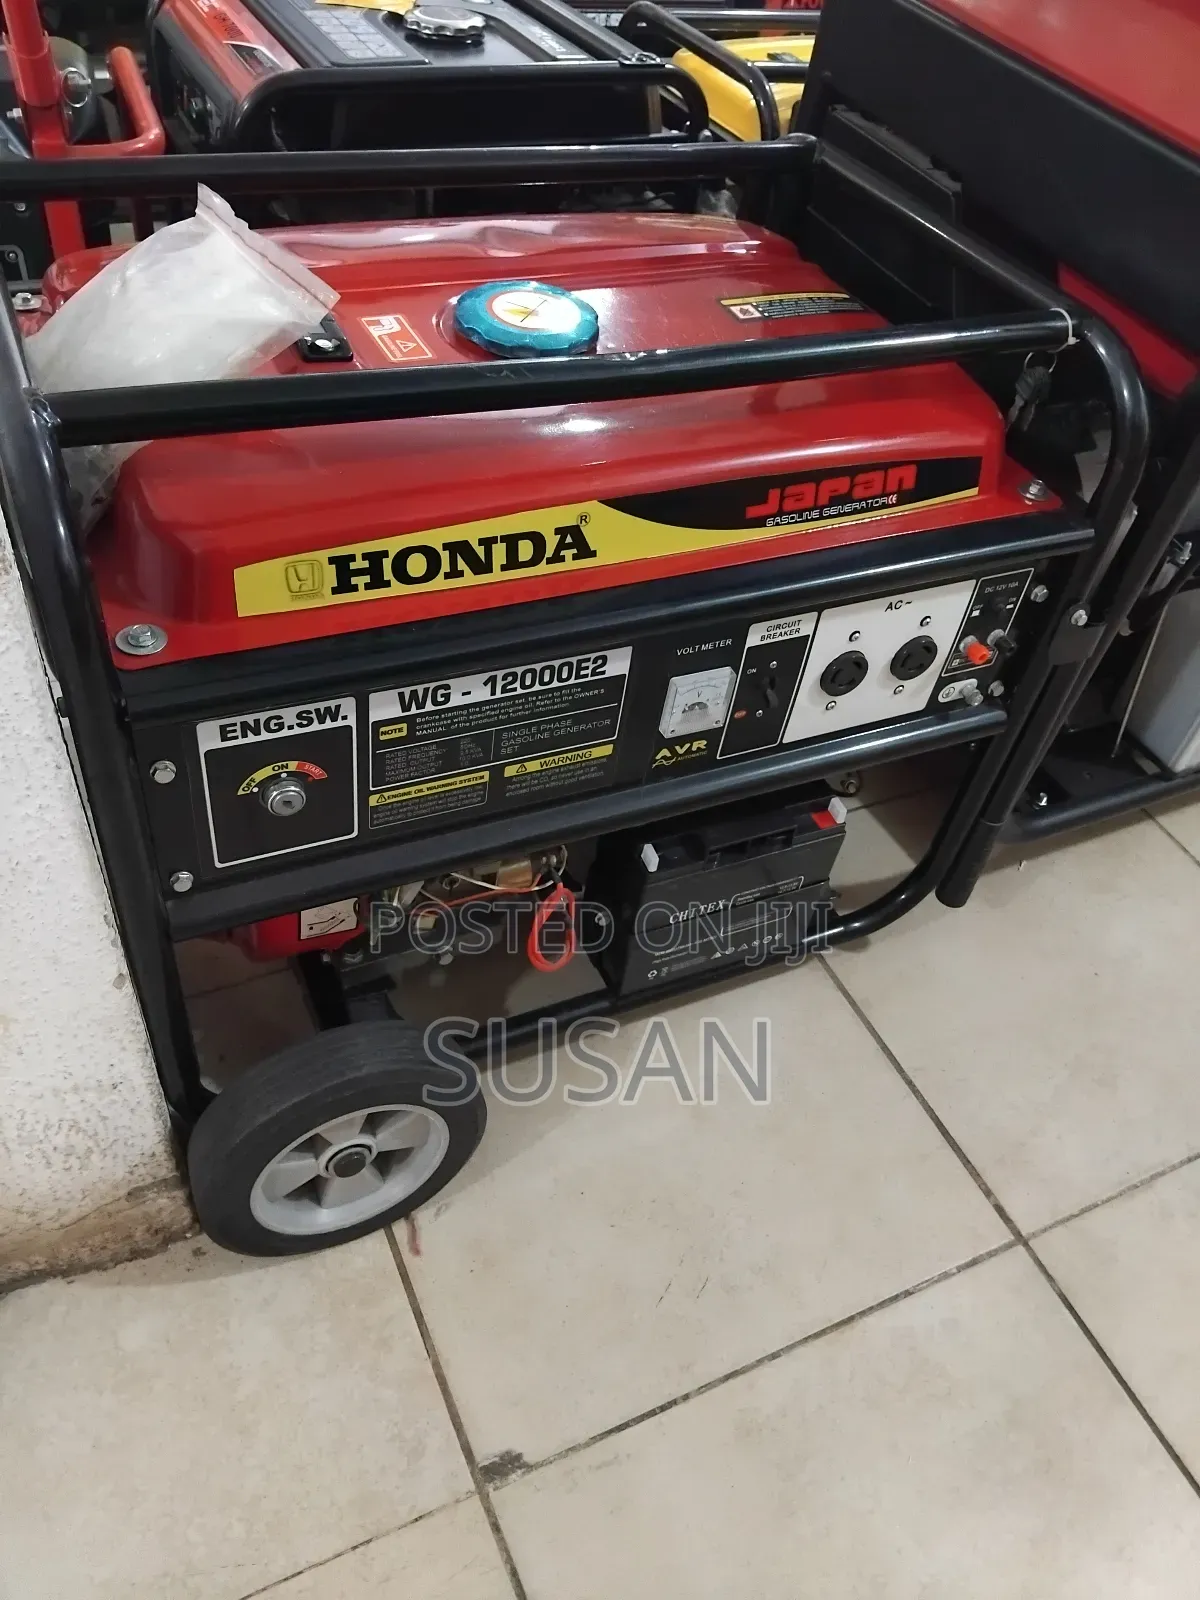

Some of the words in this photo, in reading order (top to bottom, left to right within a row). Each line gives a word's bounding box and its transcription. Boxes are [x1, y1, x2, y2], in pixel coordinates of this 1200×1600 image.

[765, 509, 821, 527] GASOLINE
[822, 496, 888, 517] GENERATOR
[328, 524, 597, 596] HONDA
[984, 586, 995, 594] DC
[766, 619, 803, 633] CIRCUIT
[760, 627, 801, 642] BREAKER
[676, 644, 700, 656] VOLT
[700, 638, 733, 651] METER
[747, 667, 758, 675] ON
[398, 683, 451, 713] WG
[483, 655, 608, 697] 12000E2
[415, 718, 452, 730] crankcase
[453, 715, 468, 723] with
[469, 709, 500, 721] specified
[500, 703, 523, 714] engine
[536, 698, 553, 707] Refer
[562, 694, 573, 702] the
[573, 687, 606, 699] OWNER'S
[416, 714, 440, 723] Before
[440, 709, 468, 719] starting
[481, 700, 514, 712] generator
[219, 703, 348, 742] ENG.SW.
[415, 725, 447, 737] MANUAL
[471, 716, 498, 727] product
[499, 713, 509, 721] for
[509, 709, 533, 719] further
[501, 727, 538, 740] SINGLE
[540, 719, 573, 732] PHASE
[380, 726, 405, 737] NOTE
[500, 731, 551, 747] GASOLINE
[553, 718, 612, 737] GENERATOR
[385, 750, 407, 759] RATED
[408, 744, 437, 755] VOLTAGE
[500, 745, 520, 755] SET
[654, 739, 708, 760] AVR
[677, 750, 708, 761] AUTOMATIC
[272, 762, 289, 772] ON
[385, 756, 407, 765] RATED
[385, 763, 406, 771] RATED
[409, 756, 436, 766] OUTPUT
[539, 750, 593, 768] WARNING
[303, 764, 323, 776] START
[385, 767, 416, 776] MAXIMUM
[417, 760, 443, 771] OUTPUT
[385, 774, 408, 783] POWER
[410, 768, 437, 777] FACTOR
[242, 777, 257, 792] OFF
[387, 790, 413, 800] ENGINE
[414, 786, 425, 794] OIL
[426, 780, 458, 791] WARNING
[458, 775, 485, 785] SYSTEM
[669, 899, 727, 924] CHITEX
